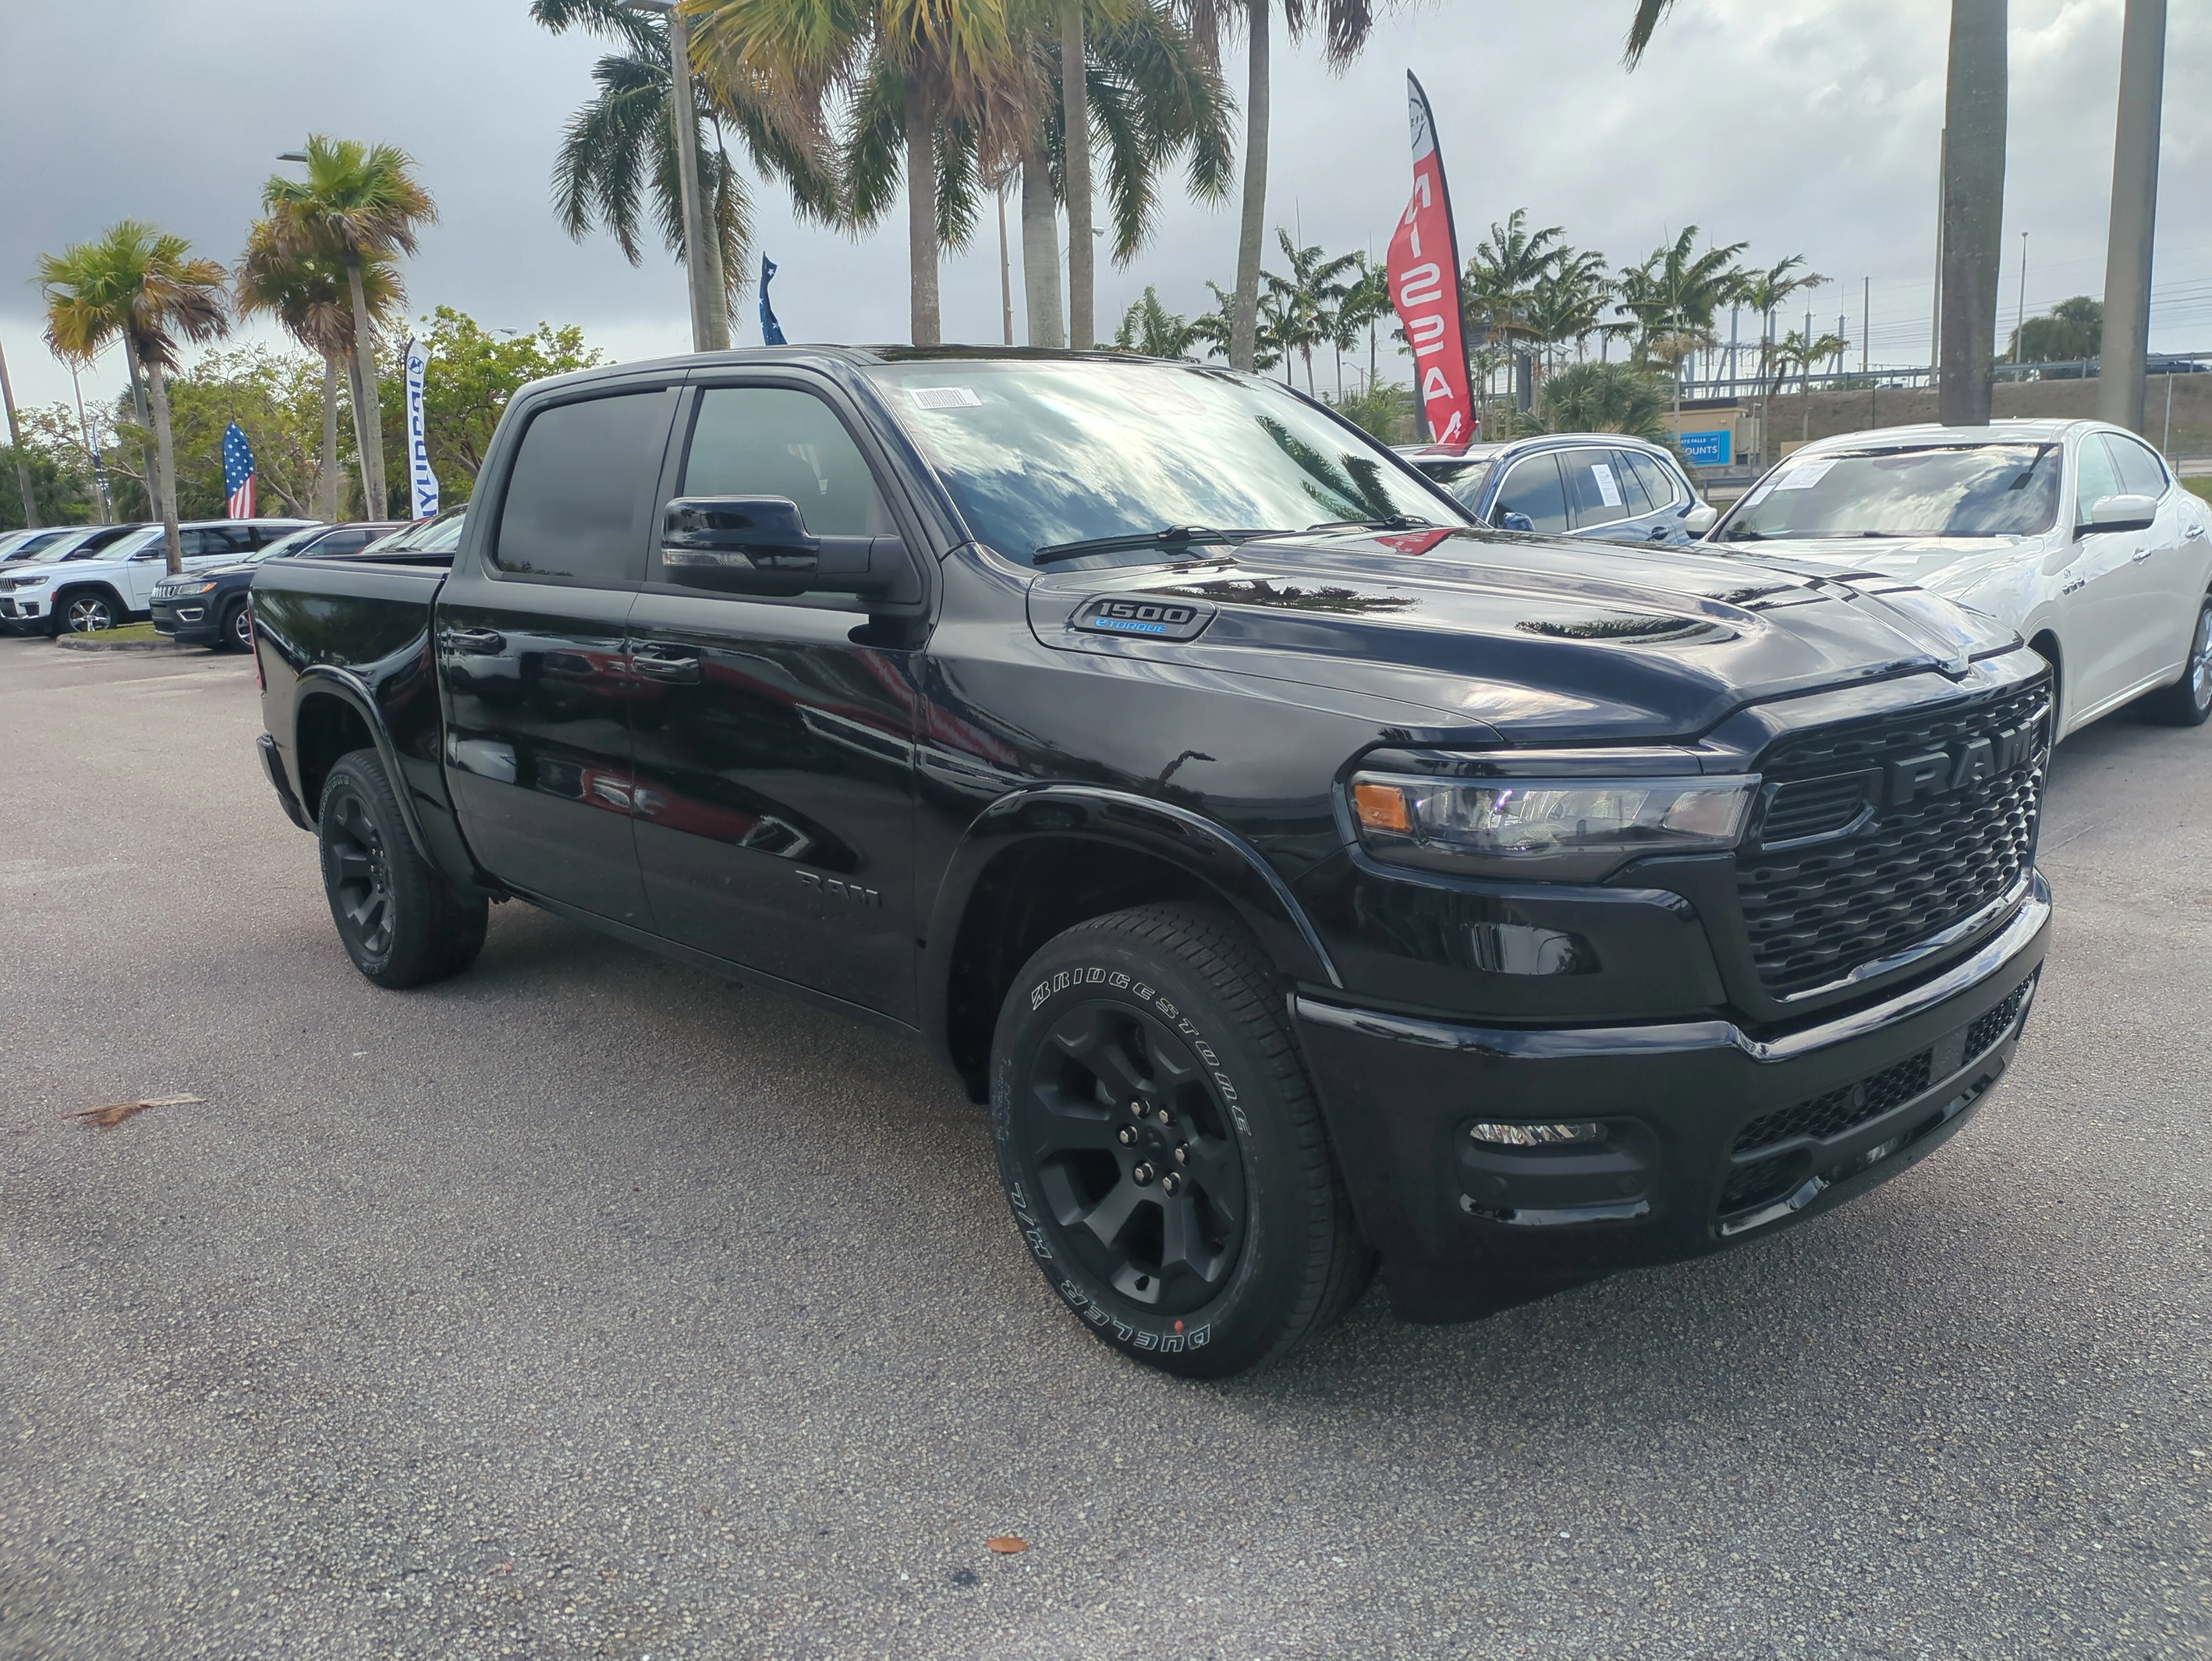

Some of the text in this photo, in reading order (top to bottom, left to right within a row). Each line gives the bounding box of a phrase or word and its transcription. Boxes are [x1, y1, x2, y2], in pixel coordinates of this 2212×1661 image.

[1683, 445, 1717, 455] OUNTS
[1100, 602, 1192, 623] 1500
[1891, 721, 2031, 806] RAM
[794, 870, 882, 909] RAM
[1031, 967, 1252, 1137] BRIDGESTONE
[1061, 1279, 1211, 1353] DUELER
